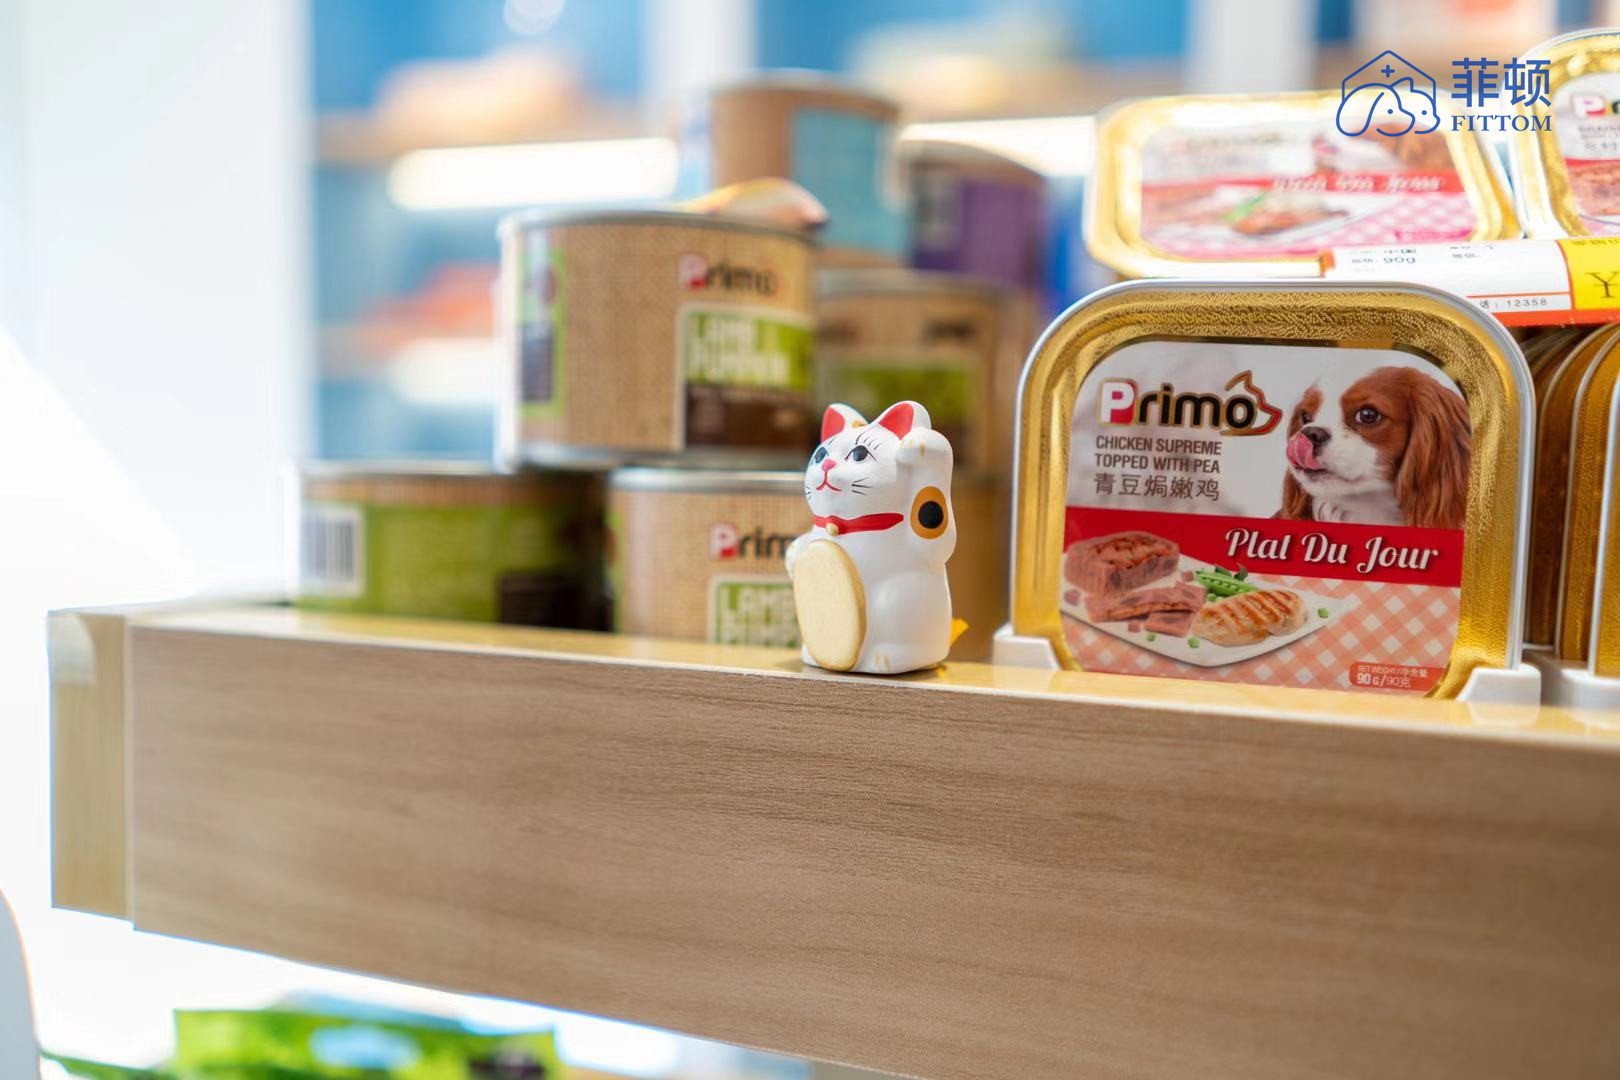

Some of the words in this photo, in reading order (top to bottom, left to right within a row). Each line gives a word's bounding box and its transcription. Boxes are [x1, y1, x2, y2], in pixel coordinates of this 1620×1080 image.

[678, 254, 776, 297] Primo
[1099, 378, 1260, 430] Primo
[1095, 453, 1148, 469] TOPPED
[1153, 456, 1189, 471] WITH
[1193, 459, 1220, 473] PEA
[1096, 435, 1153, 451] CHICKEN
[1156, 438, 1222, 455] SUPREME
[1095, 472, 1220, 501] 青豆焗嫩鸡
[709, 523, 799, 560] Prim
[1225, 527, 1290, 560] Plat
[1301, 532, 1348, 564] Du
[1357, 536, 1439, 574] Jour
